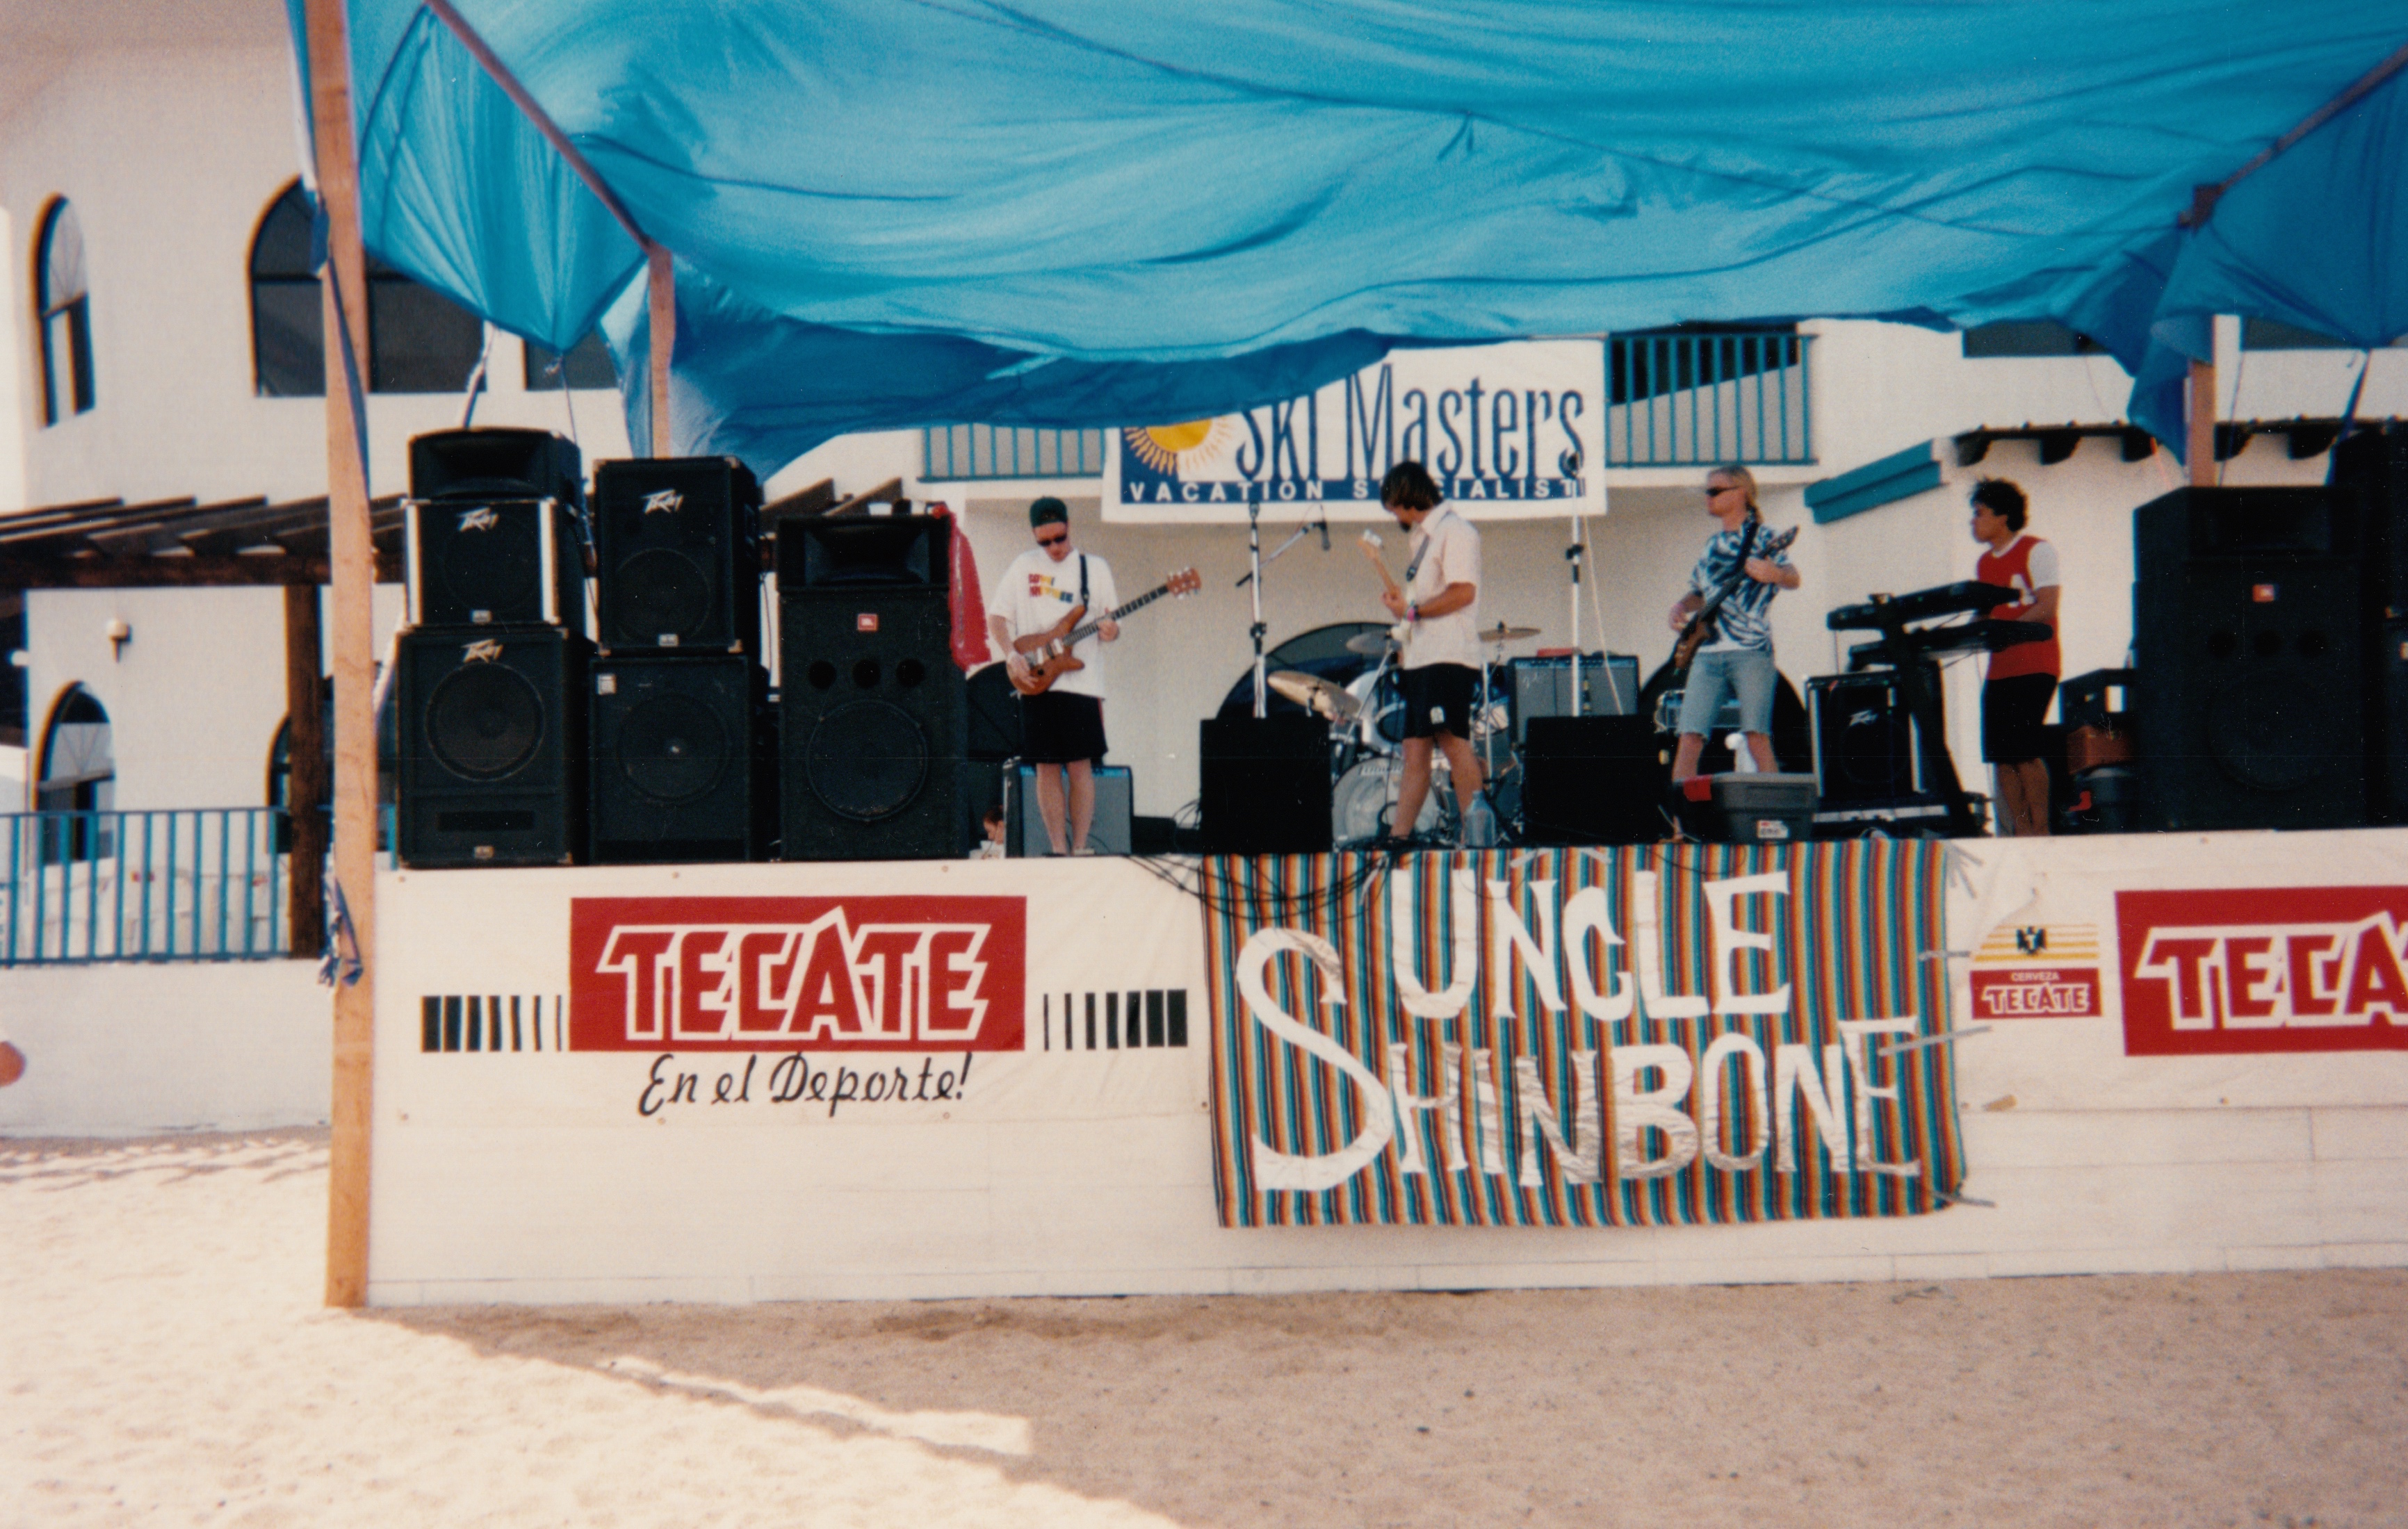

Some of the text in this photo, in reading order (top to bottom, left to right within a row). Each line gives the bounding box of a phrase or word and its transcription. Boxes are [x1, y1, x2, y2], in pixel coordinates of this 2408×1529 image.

[1344, 363, 1585, 481] Masters
[1129, 478, 1577, 502] VACATION SIALIST
[595, 905, 991, 1041] TECATE
[1391, 867, 1791, 1022] UNCLE
[1981, 981, 2090, 1015] TECATE
[2011, 972, 2060, 981] CERVEZA
[2134, 910, 2408, 1029] TECA
[637, 1050, 973, 1118] En el Deporte!
[1235, 926, 1921, 1191] SHINBONE
